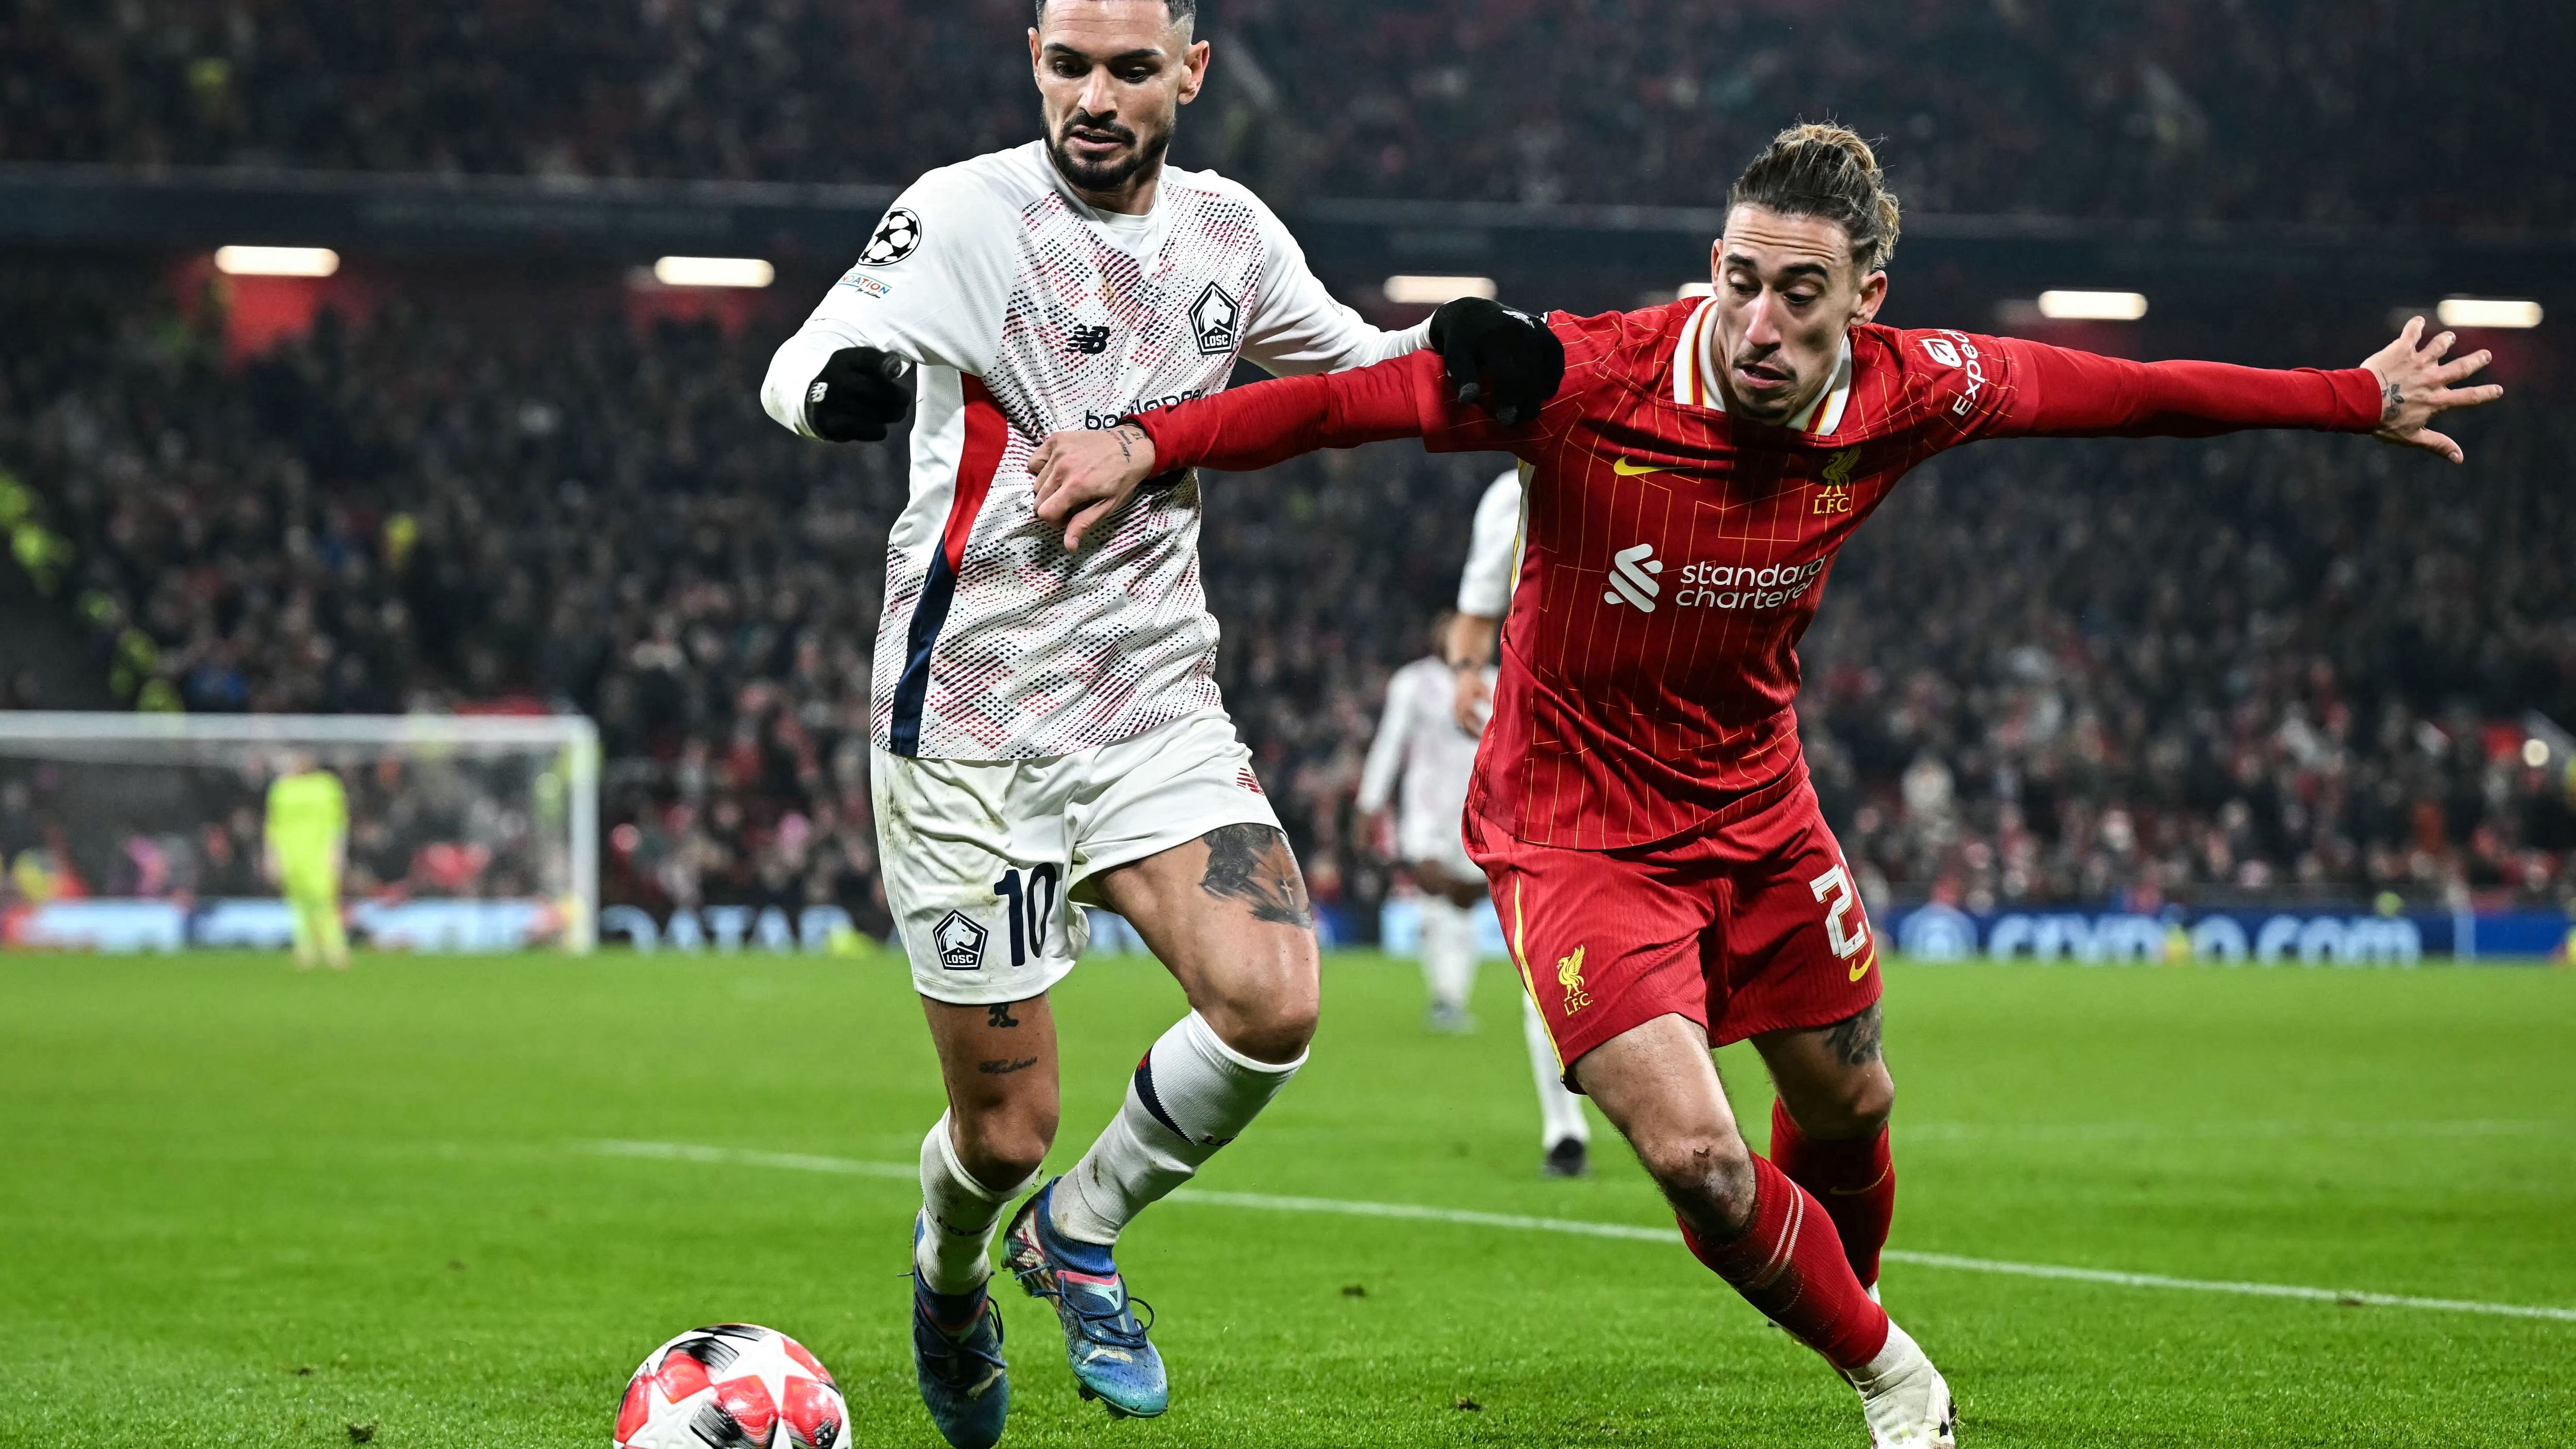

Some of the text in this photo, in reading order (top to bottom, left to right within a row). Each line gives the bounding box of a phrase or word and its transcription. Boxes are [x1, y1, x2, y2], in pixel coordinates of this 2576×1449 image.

[1204, 334, 1228, 347] LOSC
[1937, 329, 1986, 416] Exped
[1813, 497, 1852, 514] L.F.C.
[1680, 554, 1827, 587] standard
[994, 862, 1057, 967] 10
[1809, 854, 1870, 961] 2
[946, 954, 974, 964] LOSC
[1563, 993, 1594, 1016] L.F.C.
